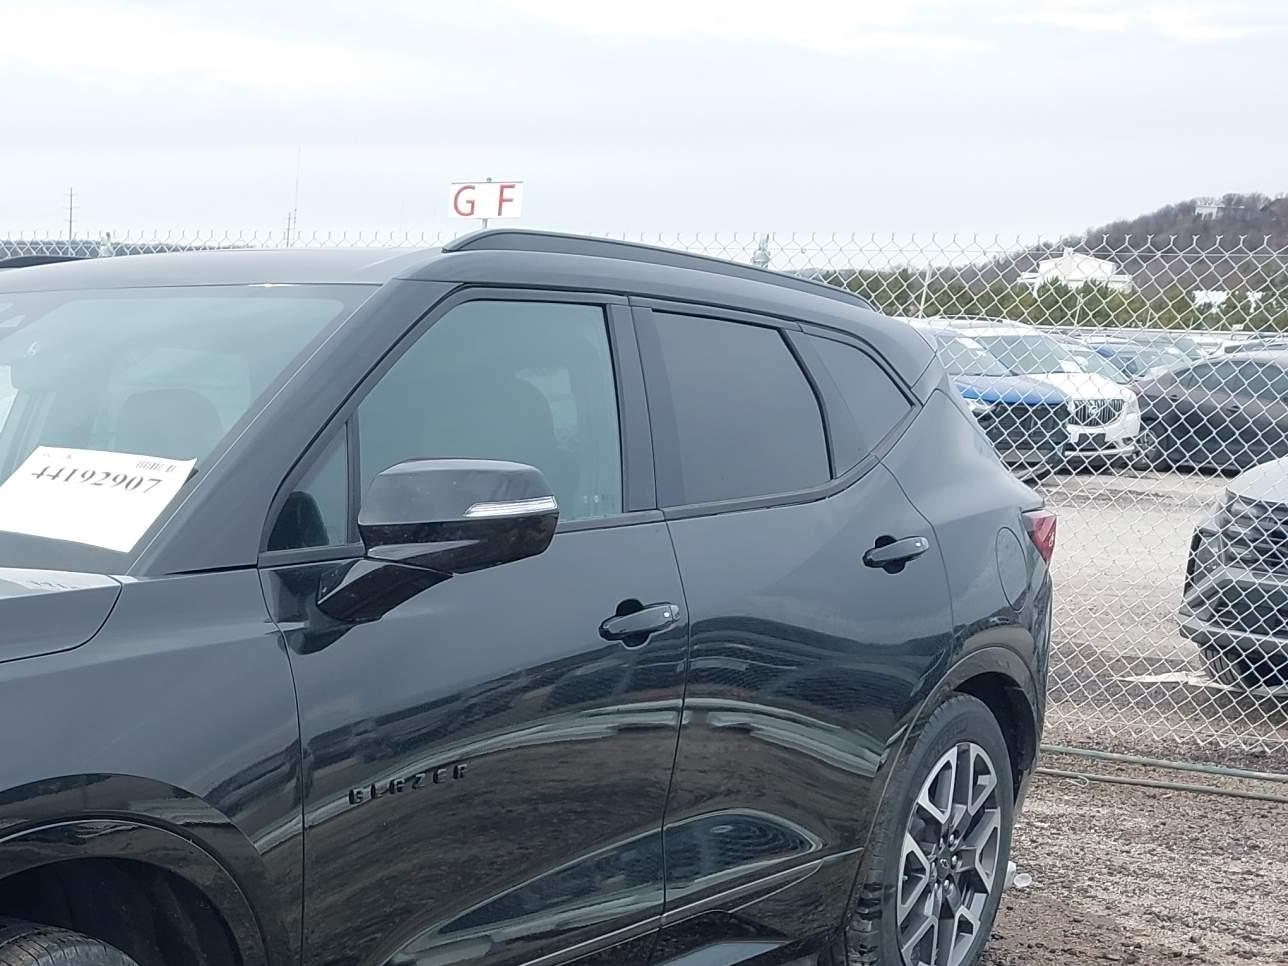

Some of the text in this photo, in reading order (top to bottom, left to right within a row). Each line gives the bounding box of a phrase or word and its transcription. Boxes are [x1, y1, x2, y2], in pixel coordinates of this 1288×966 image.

[453, 184, 516, 217] G F
[31, 465, 164, 494] 44192907
[348, 763, 468, 805] BLAZER
